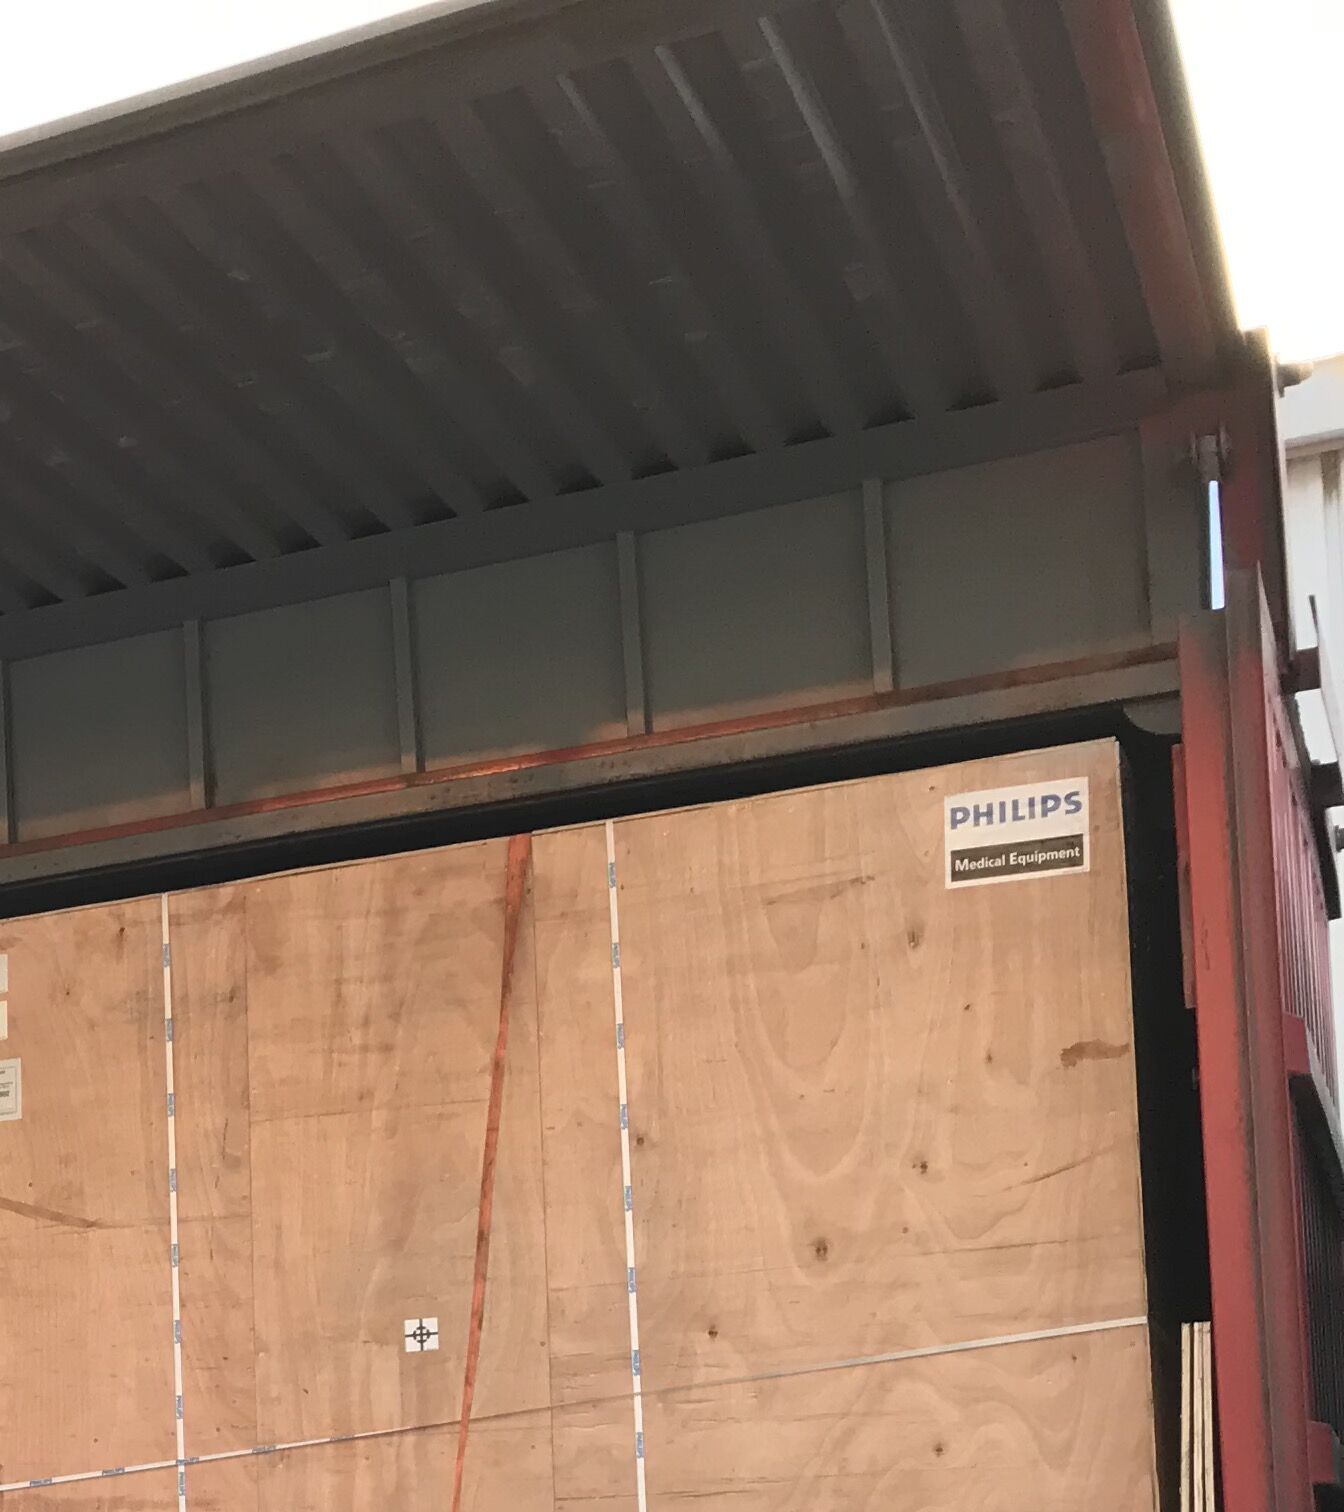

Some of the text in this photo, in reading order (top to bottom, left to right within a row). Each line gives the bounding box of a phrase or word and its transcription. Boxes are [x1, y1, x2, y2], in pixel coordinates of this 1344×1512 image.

[950, 791, 1083, 830] PHILIPS
[954, 846, 1081, 872] Medical Equipment
